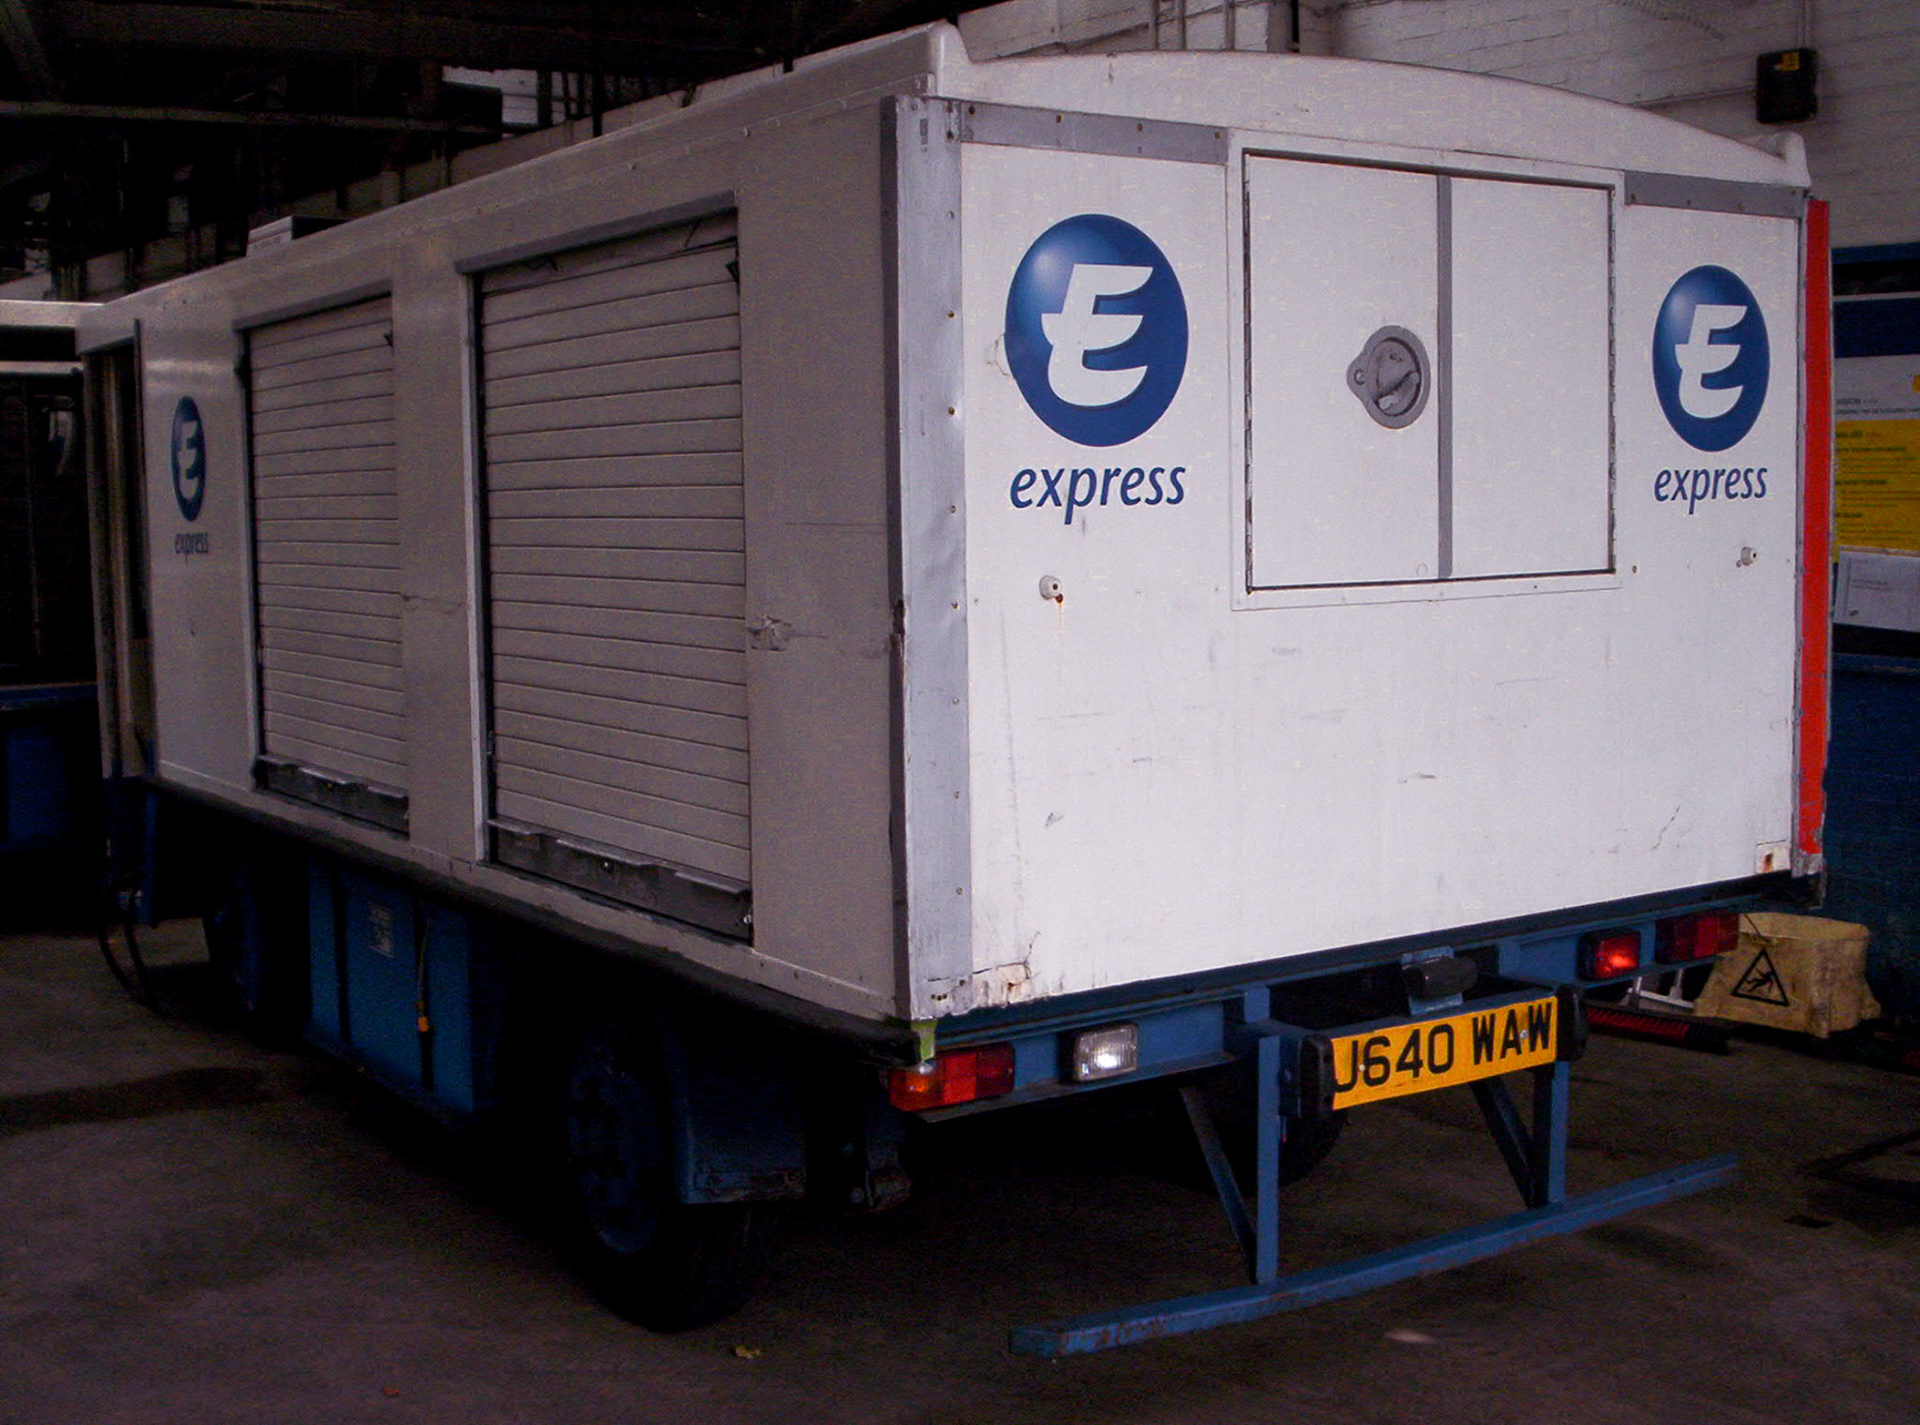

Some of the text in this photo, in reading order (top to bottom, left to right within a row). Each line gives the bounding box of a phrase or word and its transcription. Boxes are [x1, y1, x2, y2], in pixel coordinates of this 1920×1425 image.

[1010, 466, 1186, 525] express
[1654, 467, 1767, 515] express
[175, 532, 209, 565] express
[1332, 1002, 1552, 1093] J640 WAW
